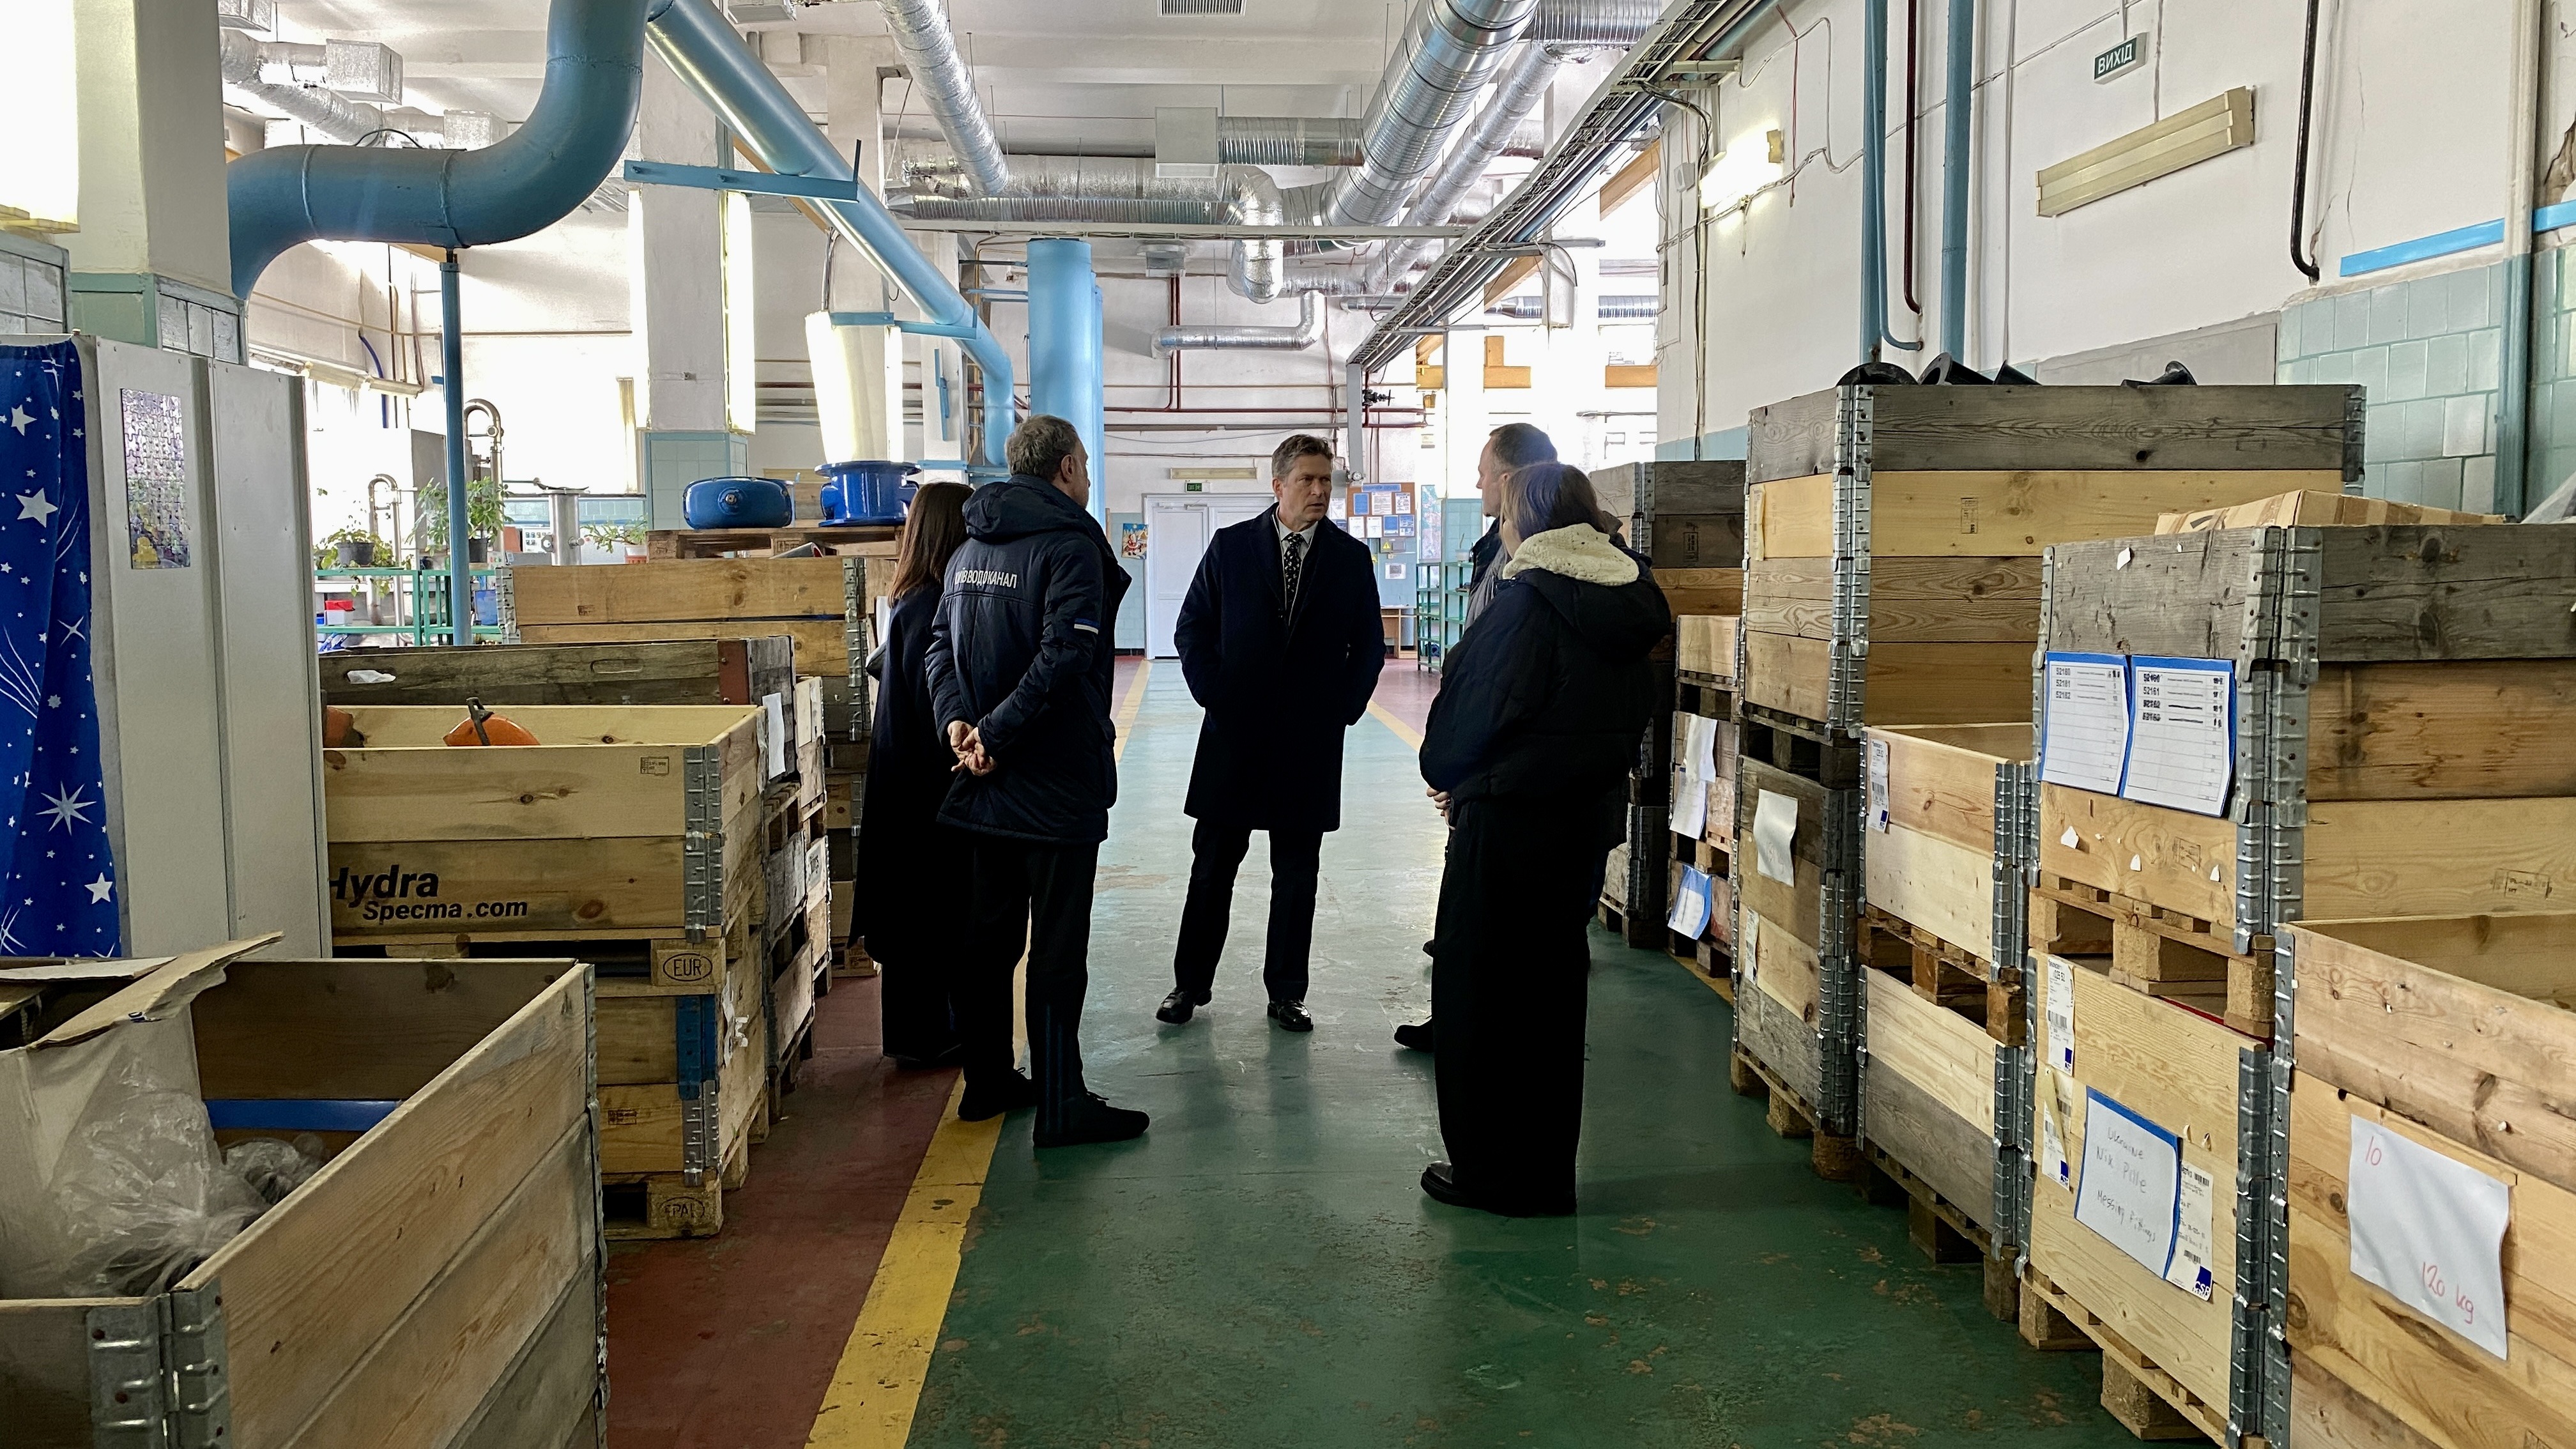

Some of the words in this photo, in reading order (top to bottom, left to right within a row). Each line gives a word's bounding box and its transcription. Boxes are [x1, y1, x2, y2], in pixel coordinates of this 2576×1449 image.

[2097, 43, 2133, 75] ВИХІД
[329, 864, 439, 908] Hydra
[673, 959, 702, 976] EUR
[2421, 1262, 2446, 1298] 120
[2455, 1285, 2474, 1324] kg
